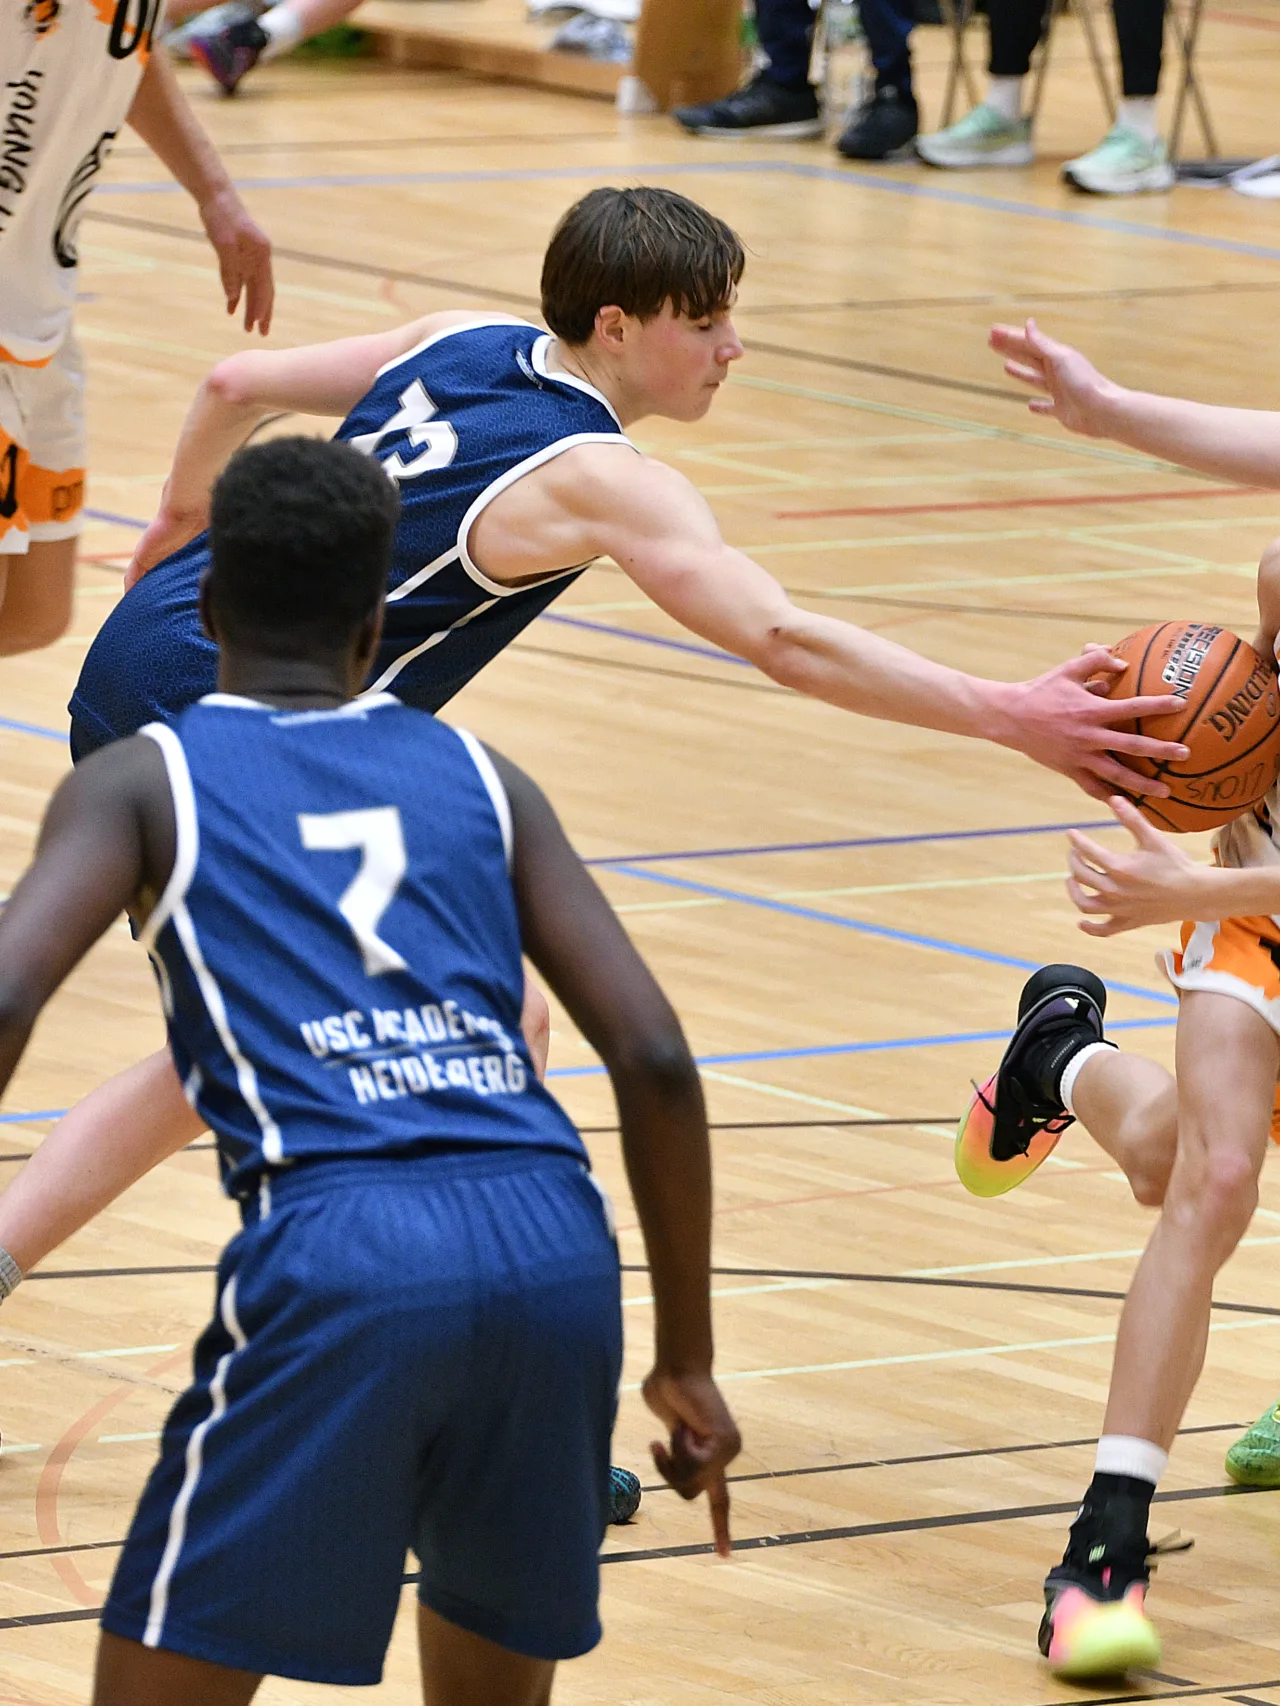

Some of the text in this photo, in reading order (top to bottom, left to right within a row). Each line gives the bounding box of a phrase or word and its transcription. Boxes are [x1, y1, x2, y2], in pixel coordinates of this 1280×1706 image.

[297, 805, 410, 977] 7
[301, 1000, 514, 1058] USC ACADES
[349, 1051, 527, 1105] HEIDEBERG
